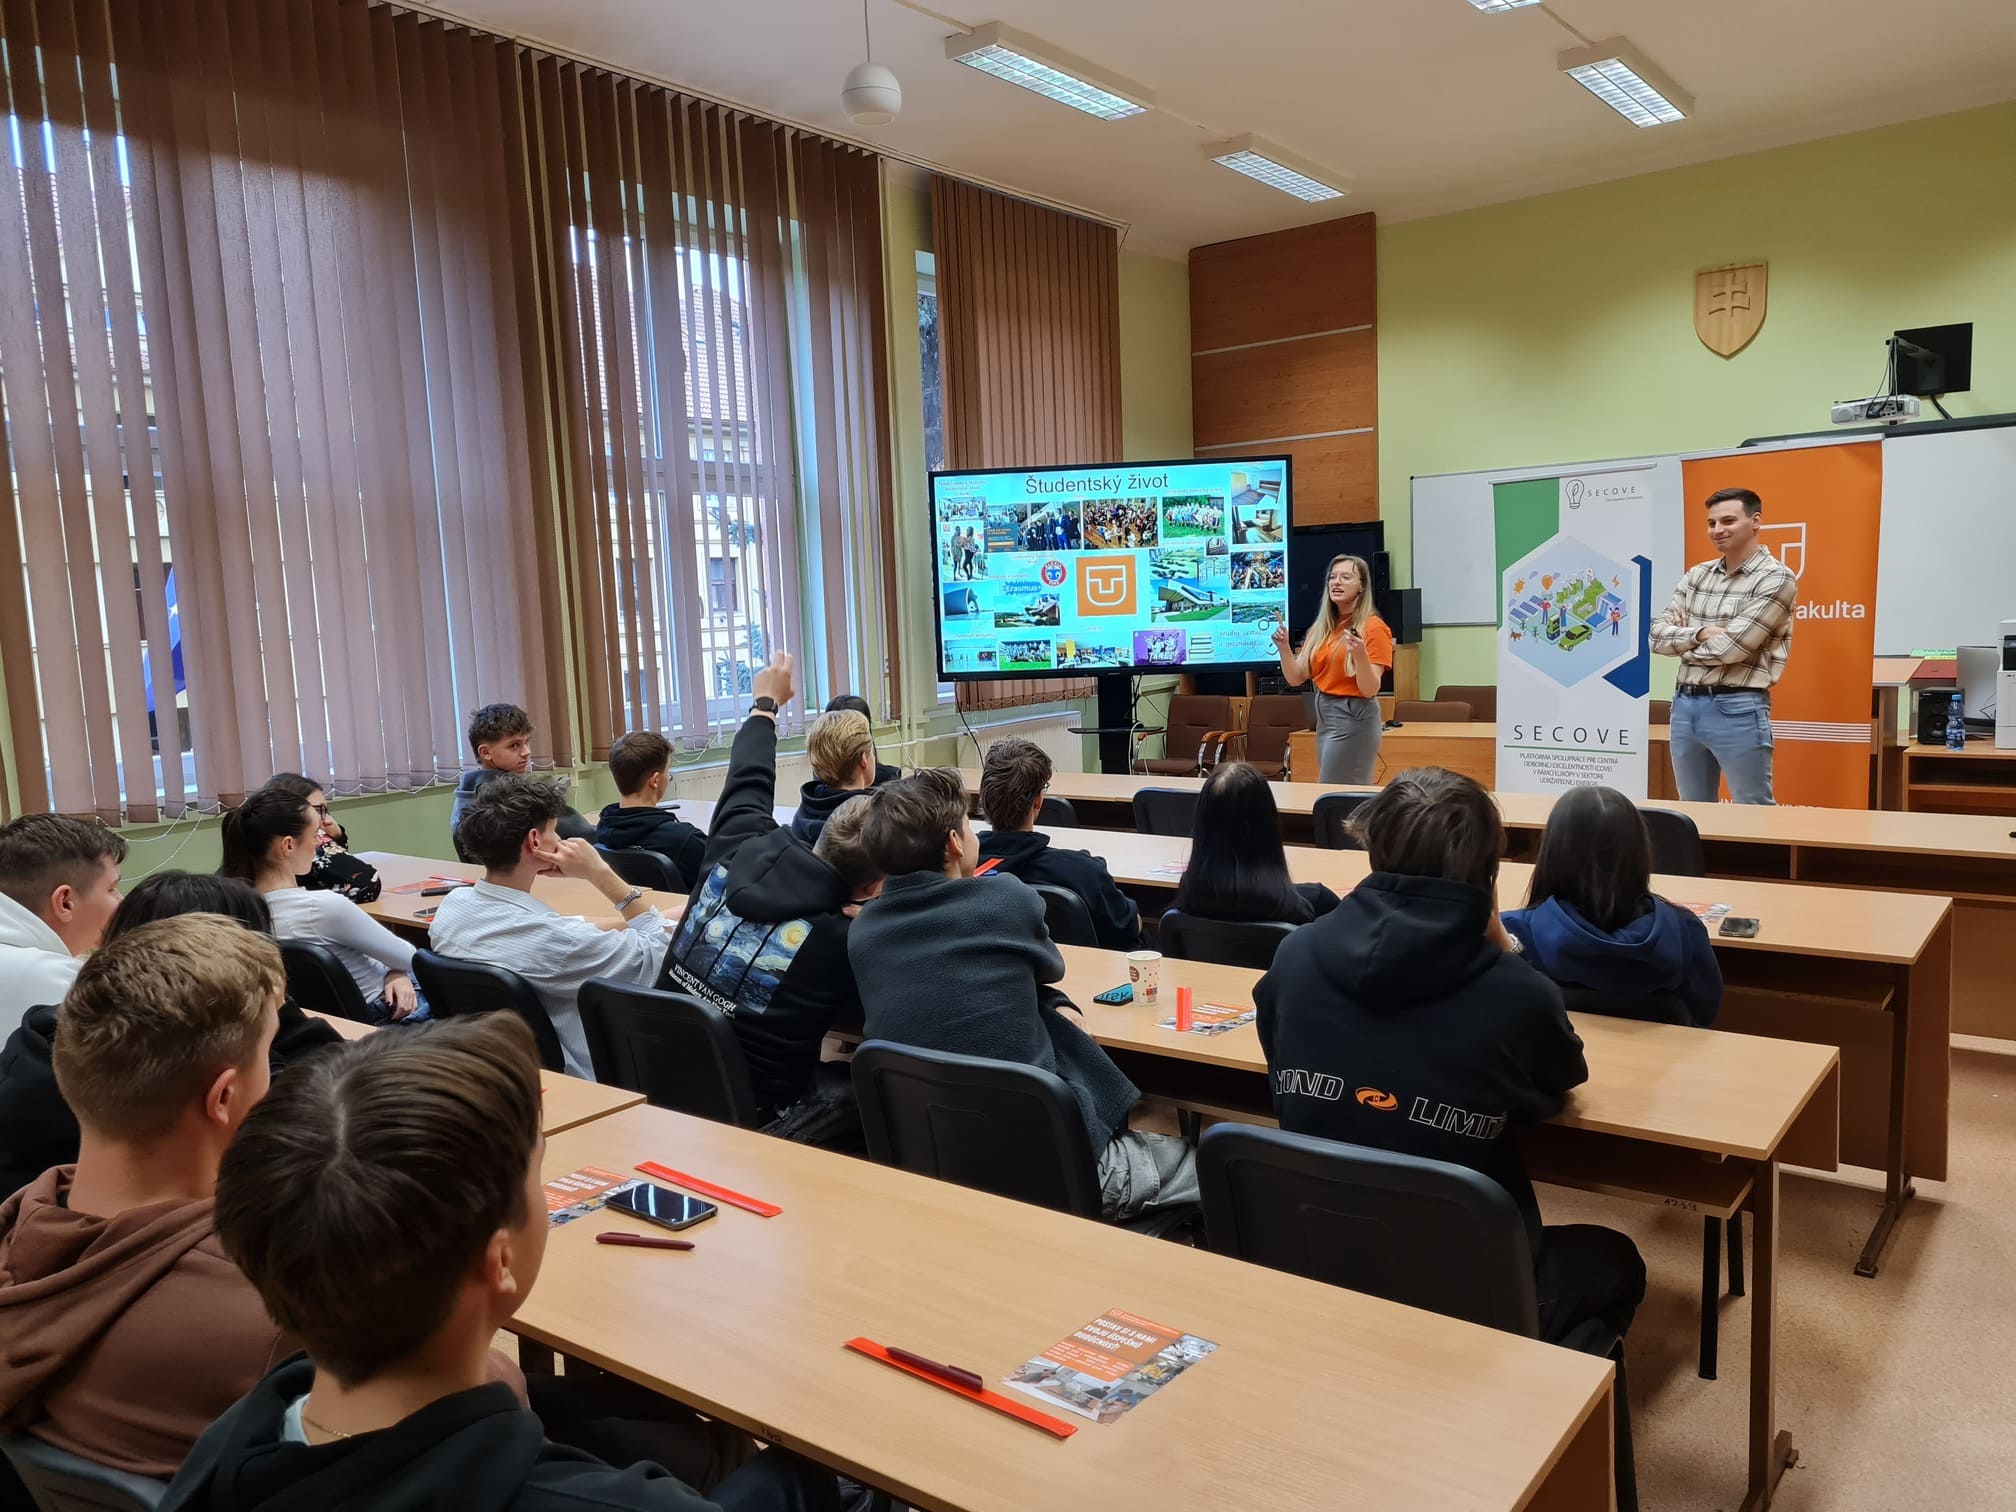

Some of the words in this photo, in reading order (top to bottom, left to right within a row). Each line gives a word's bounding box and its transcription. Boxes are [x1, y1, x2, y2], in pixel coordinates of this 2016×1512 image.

[1025, 474, 1122, 494] Študentský
[1127, 472, 1169, 490] život
[1587, 485, 1637, 498] SECOVE
[1513, 724, 1630, 746] SECOVE
[1519, 752, 1552, 761] PLATFORMA
[674, 963, 700, 987] VINCENT
[698, 982, 715, 998] VAN
[712, 993, 737, 1012] GOGH
[1094, 1318, 1121, 1332] POSTAV
